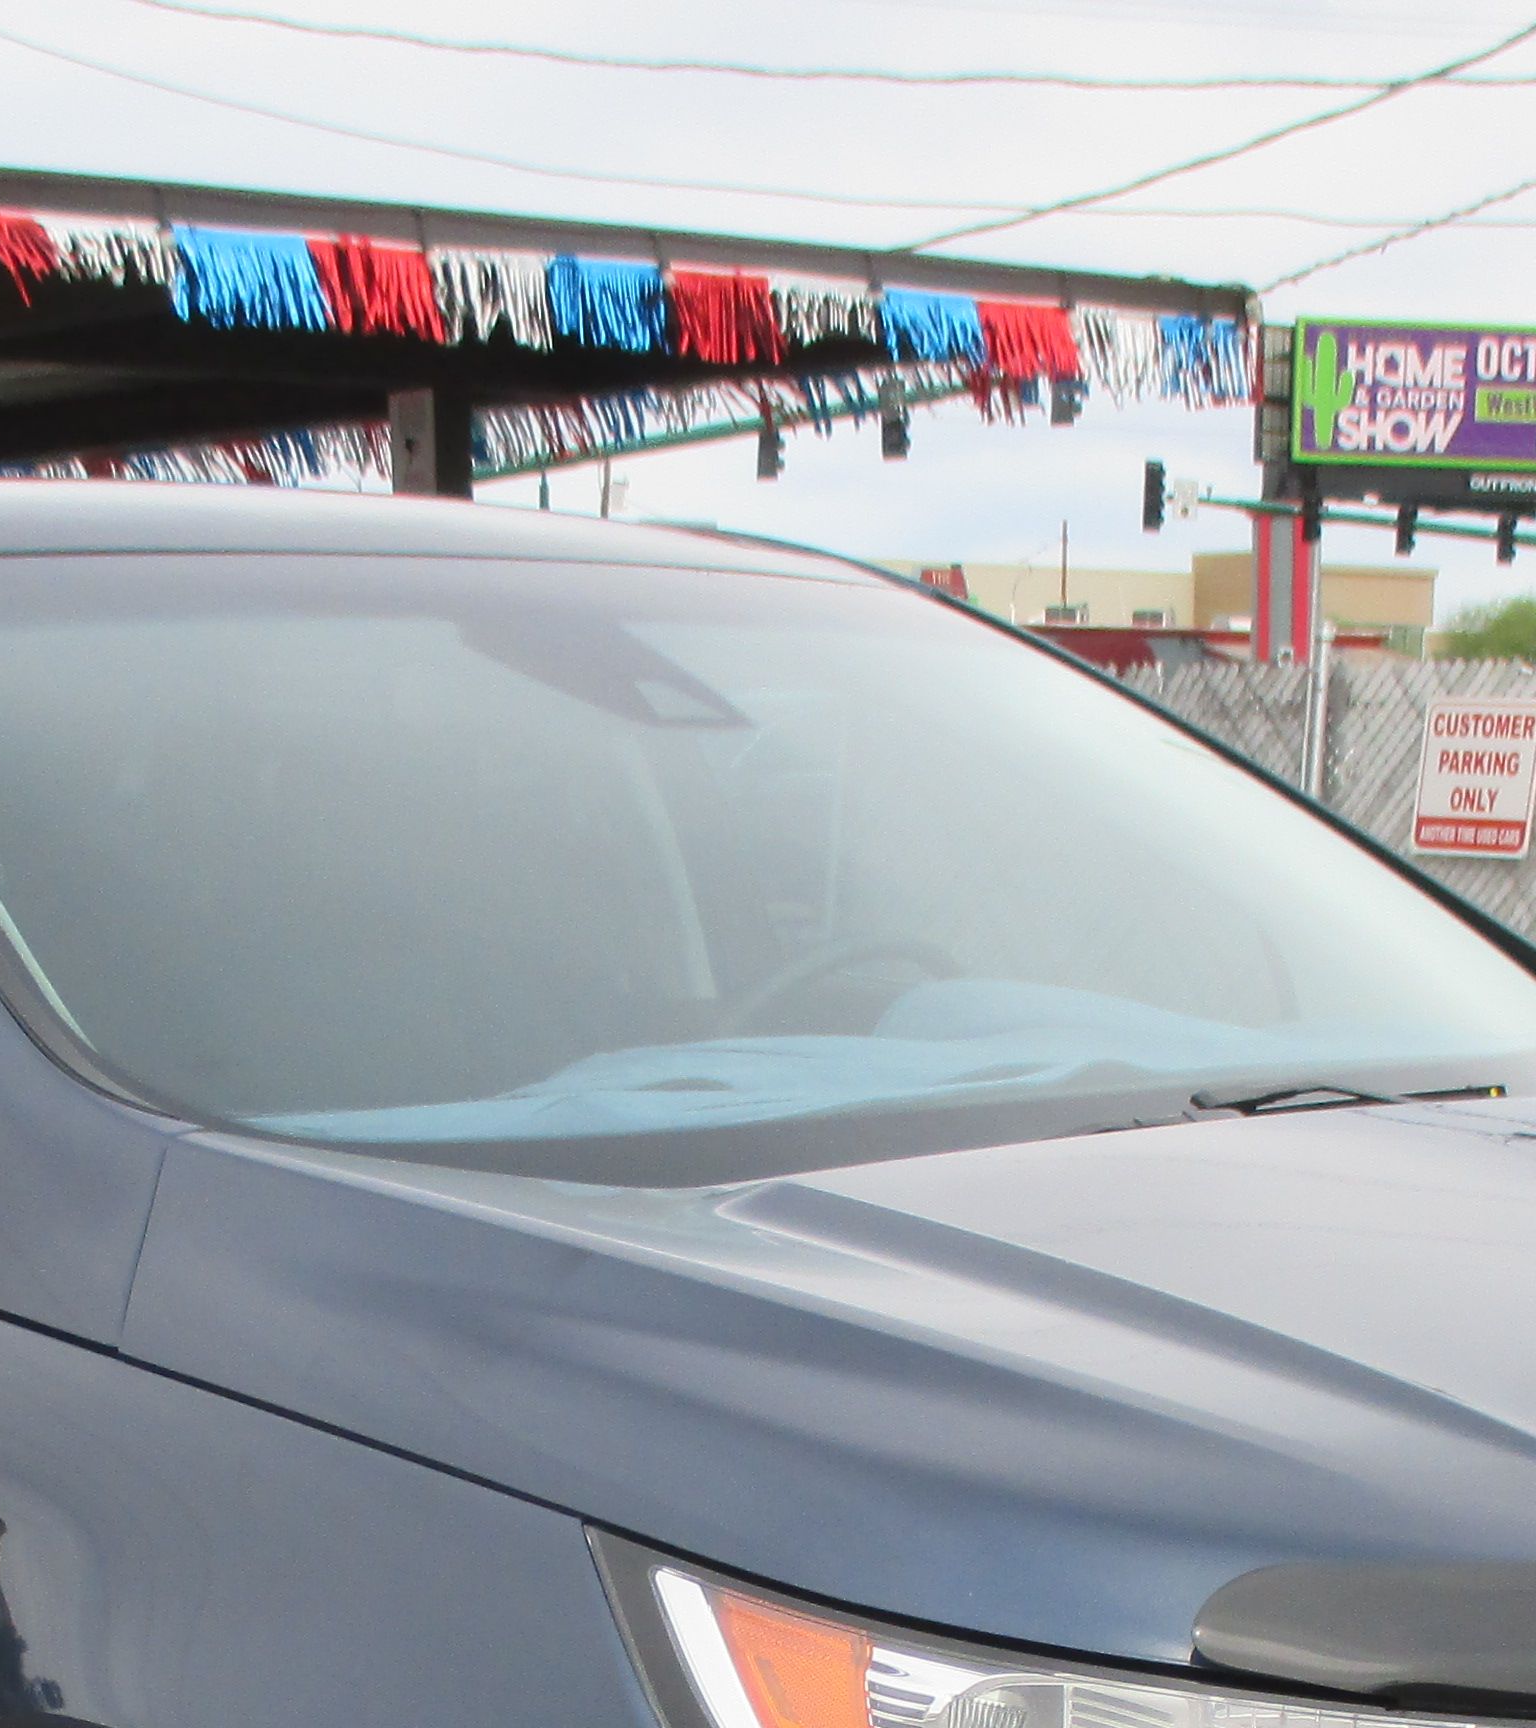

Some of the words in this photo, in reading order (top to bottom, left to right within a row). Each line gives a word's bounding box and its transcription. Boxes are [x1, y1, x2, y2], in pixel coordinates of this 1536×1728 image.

[1348, 341, 1467, 390] HOME
[1376, 386, 1464, 412] GARDEN
[1337, 407, 1464, 453] SHOW
[1433, 713, 1536, 740] CUSTOMER
[1438, 749, 1520, 777] PARKING
[1450, 787, 1499, 813] ONLY
